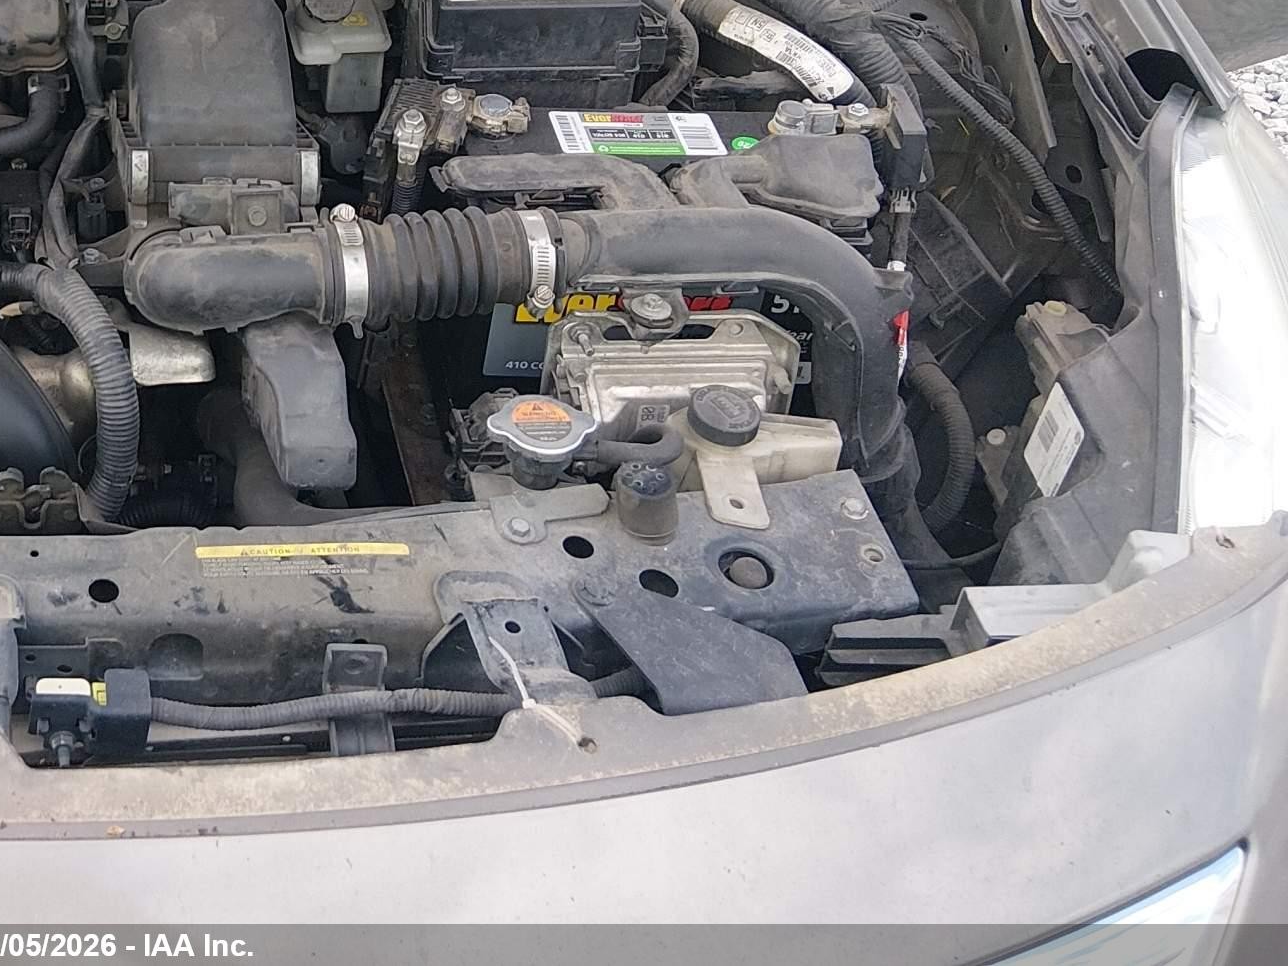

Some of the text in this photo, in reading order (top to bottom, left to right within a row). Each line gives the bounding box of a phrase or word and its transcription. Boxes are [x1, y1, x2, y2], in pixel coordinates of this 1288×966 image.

[505, 361, 529, 369] 410
[250, 548, 291, 556] CAUTION
[311, 545, 360, 554] ATTENTION
